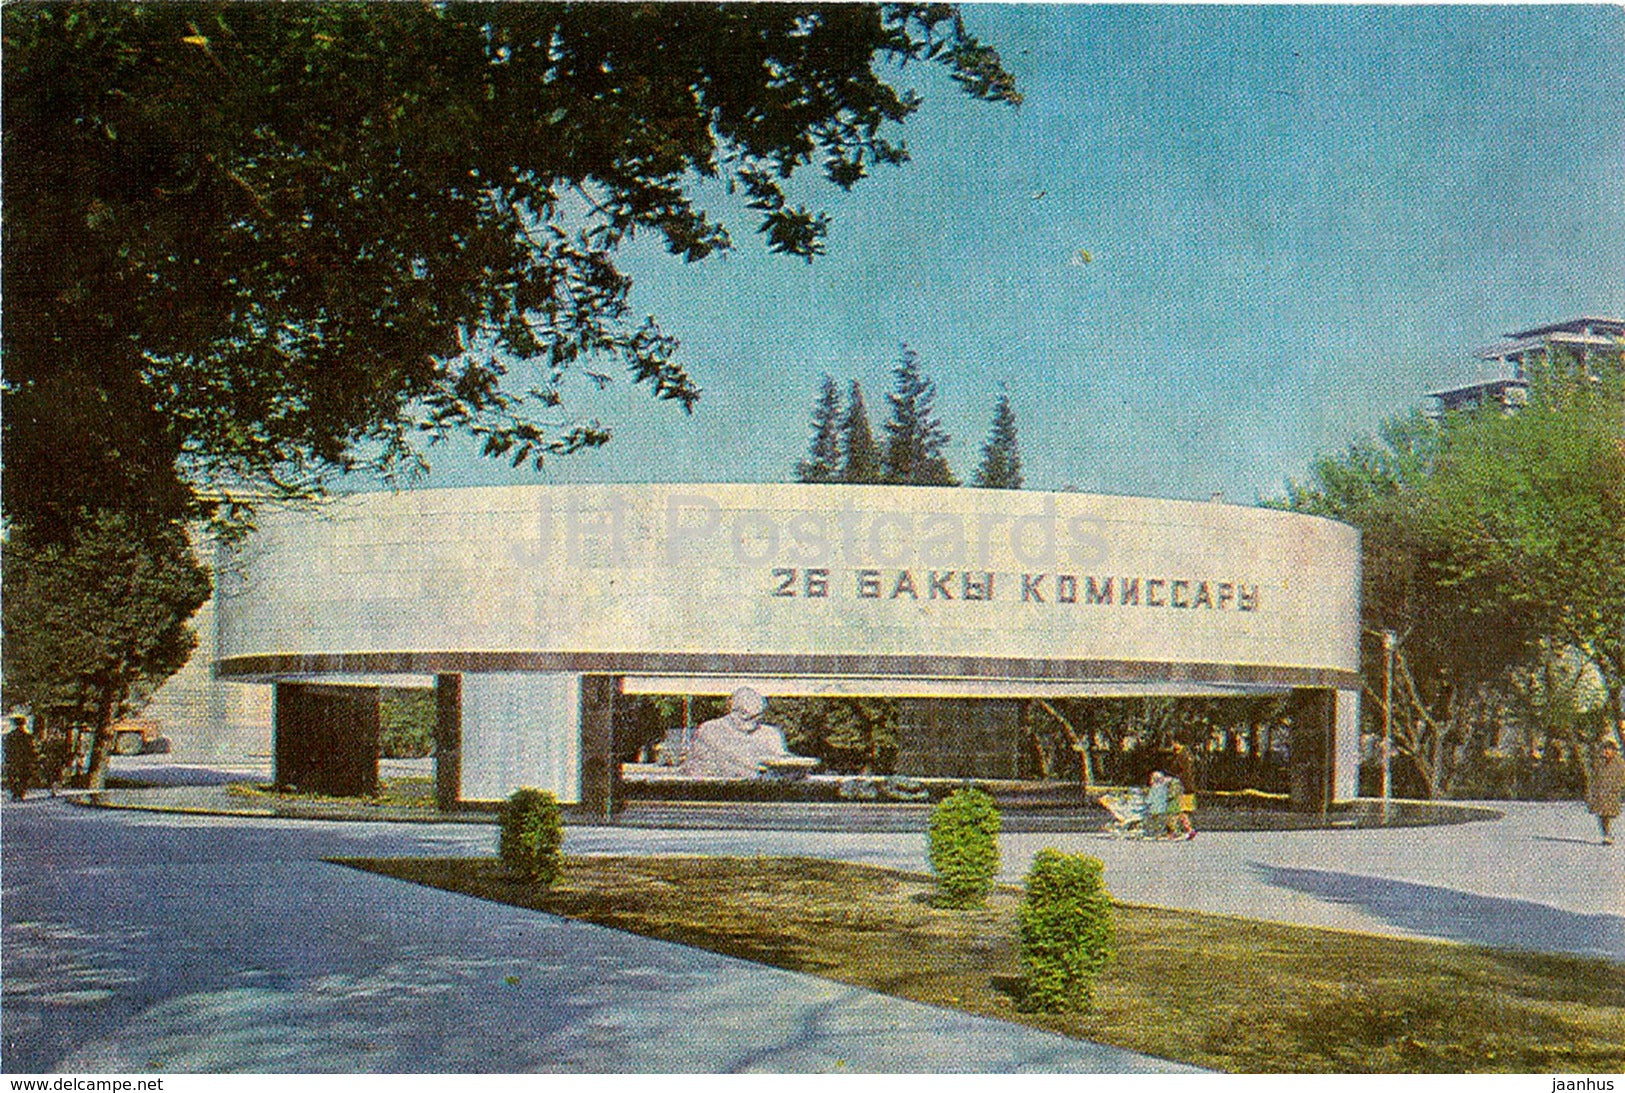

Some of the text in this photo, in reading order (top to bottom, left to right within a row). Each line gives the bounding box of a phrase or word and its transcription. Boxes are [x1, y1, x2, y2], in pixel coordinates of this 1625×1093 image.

[772, 568, 1259, 612] 26 БАКЫ КОМИССАРЫ
